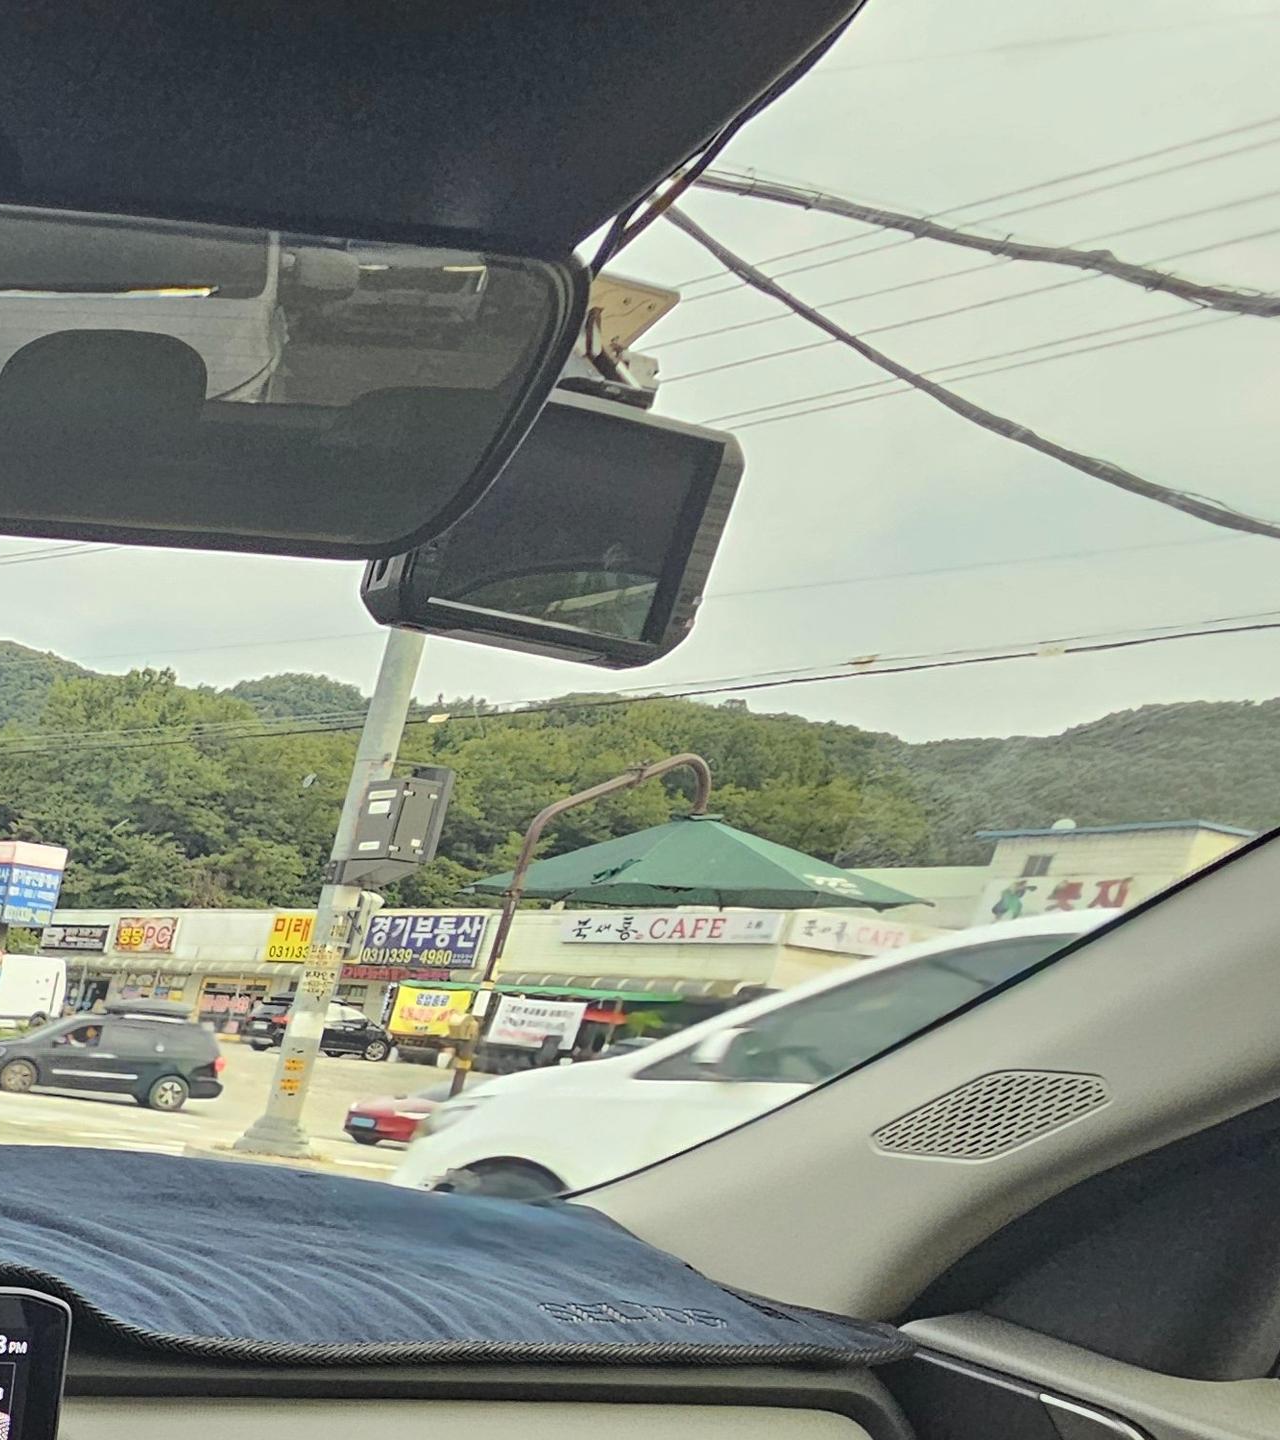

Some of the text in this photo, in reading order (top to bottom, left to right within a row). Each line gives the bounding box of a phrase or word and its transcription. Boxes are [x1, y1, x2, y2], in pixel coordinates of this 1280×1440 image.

[274, 917, 311, 942] 미래
[371, 916, 482, 948] 경기부동산
[649, 917, 728, 940] CAFE
[361, 947, 452, 965] 031)339-4980
[8, 1341, 28, 1355] PM
